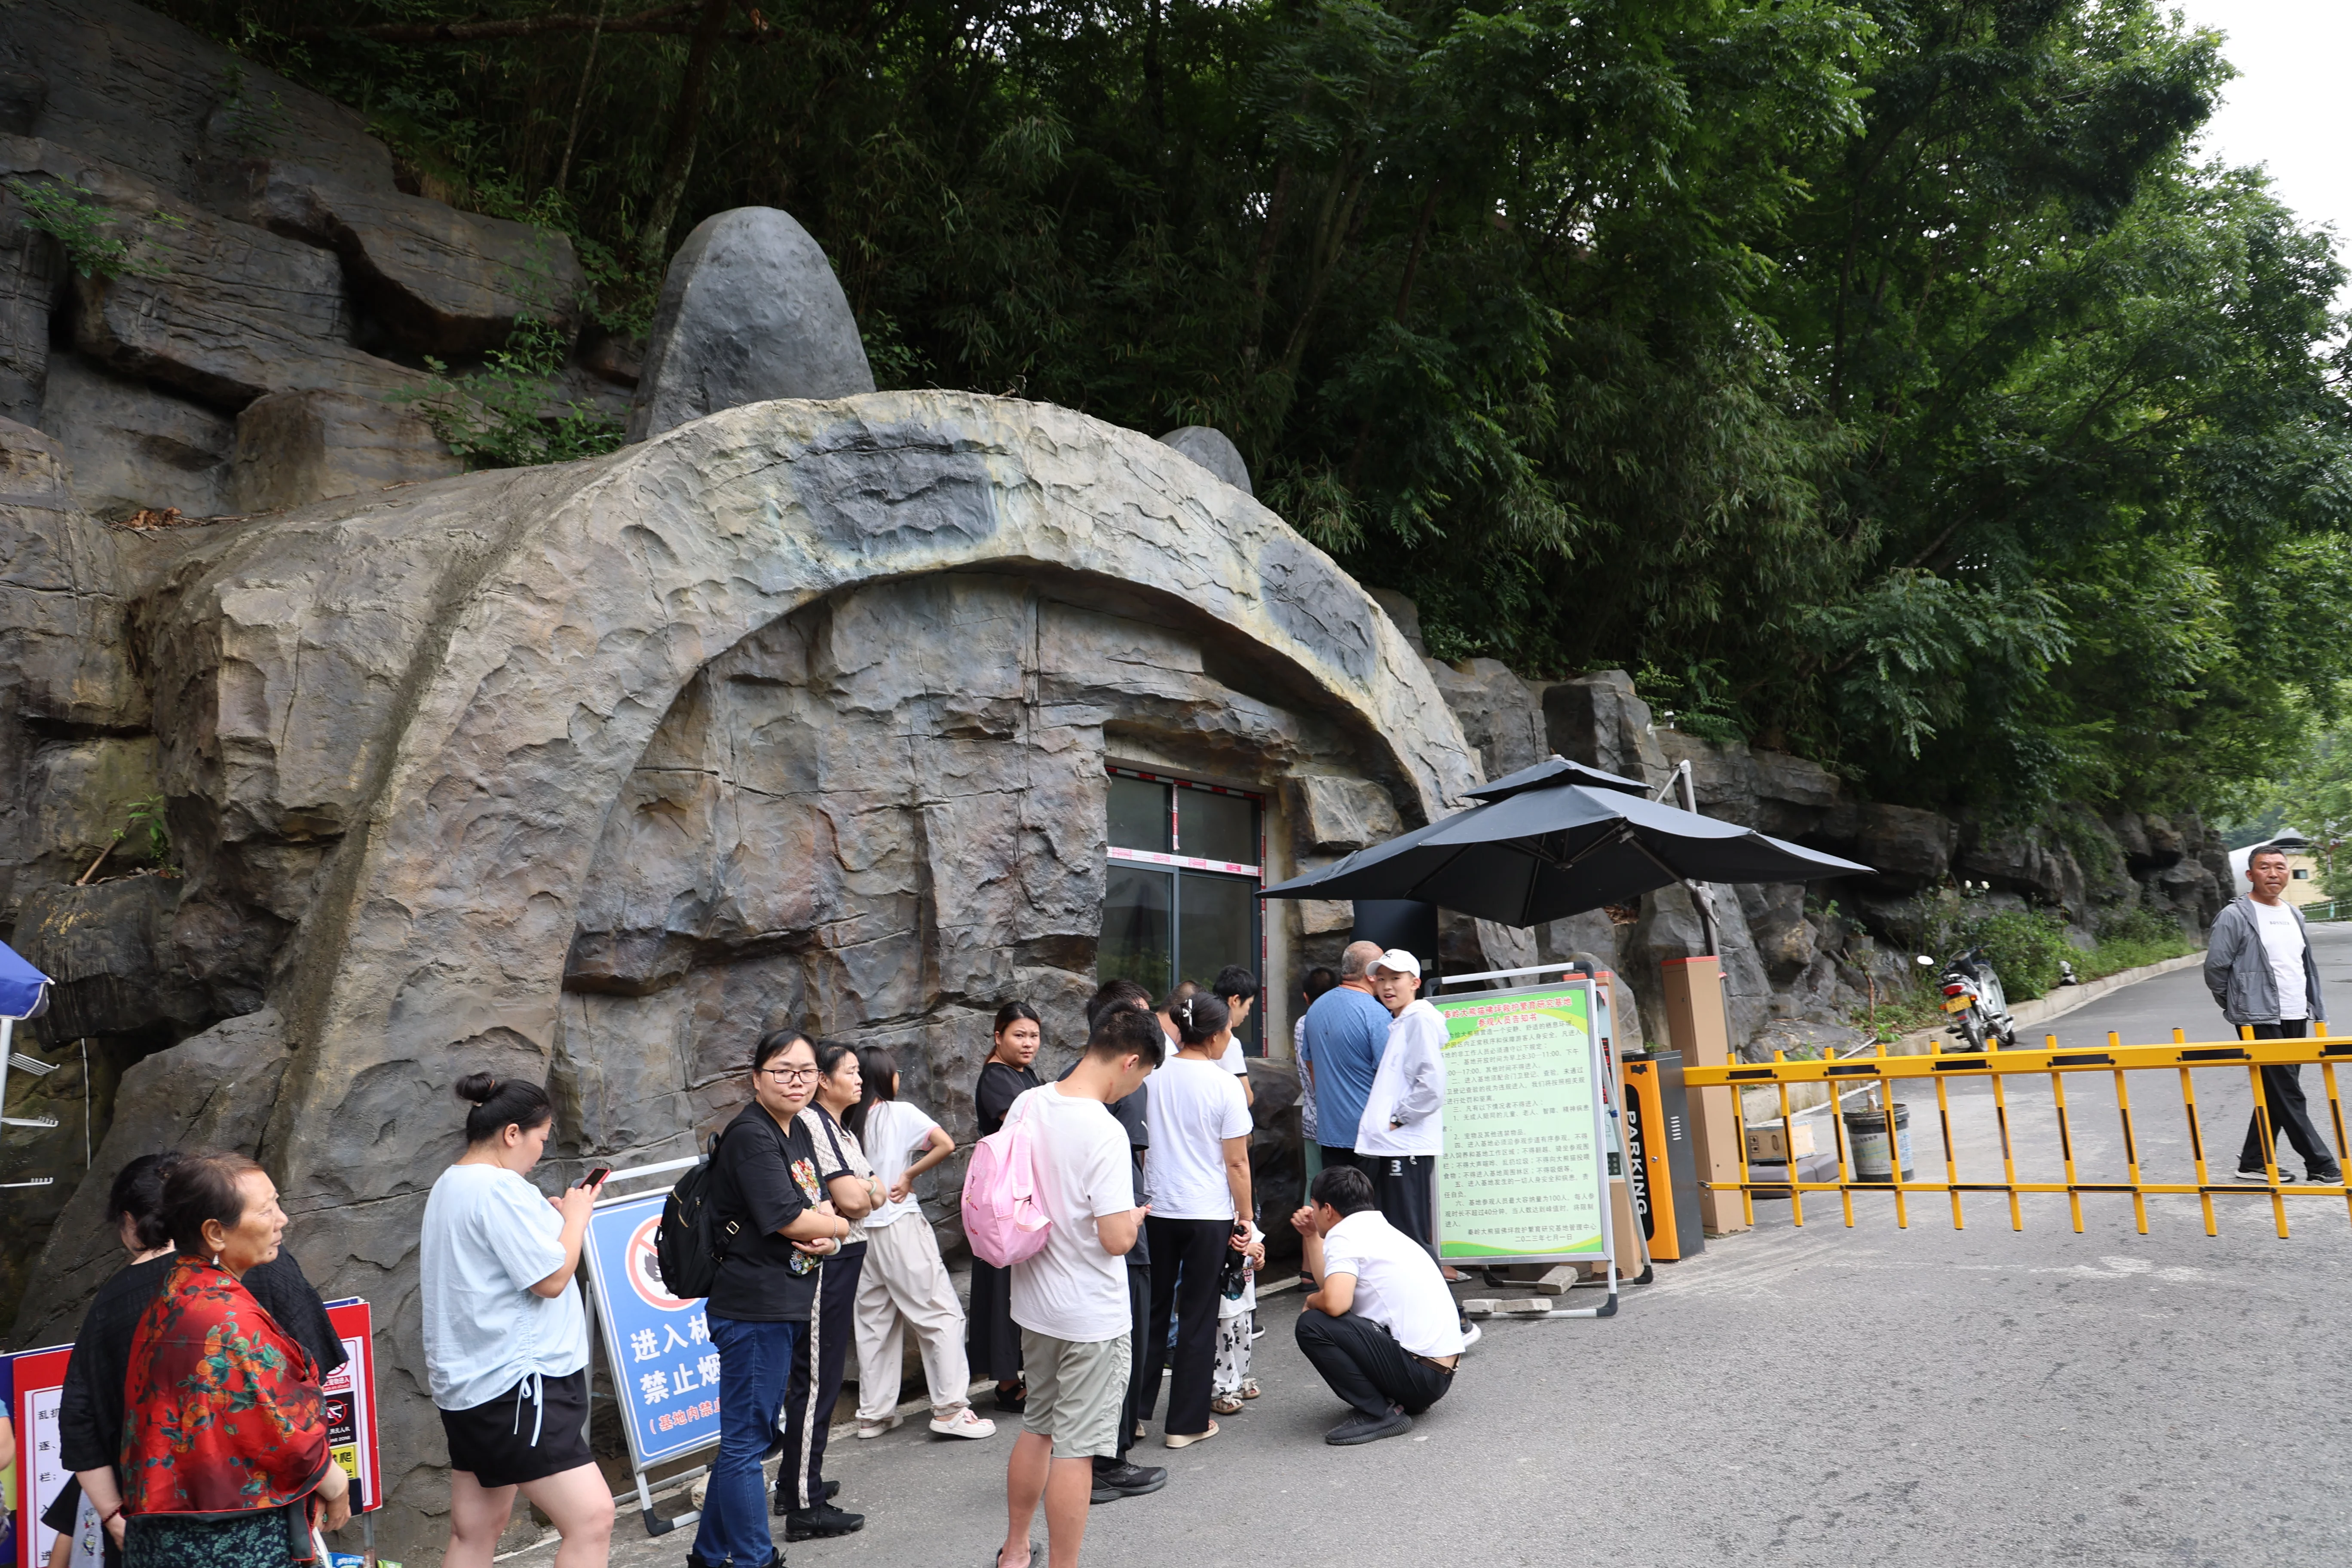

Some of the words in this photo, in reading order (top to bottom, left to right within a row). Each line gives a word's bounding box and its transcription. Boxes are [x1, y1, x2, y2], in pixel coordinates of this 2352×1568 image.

[1444, 996, 1572, 1019] 秦岭大熊猫佛坪救护繁育研究基地
[1477, 1013, 1538, 1028] 参观人员告知书
[1444, 1077, 1586, 1094] 卫登记查验的视为违规进入，我们将按照相关规
[1627, 1111, 1648, 1215] PARKING
[1468, 1224, 1597, 1235] 秦岭大熊猫佛坪救护繁育研究基地管理中心
